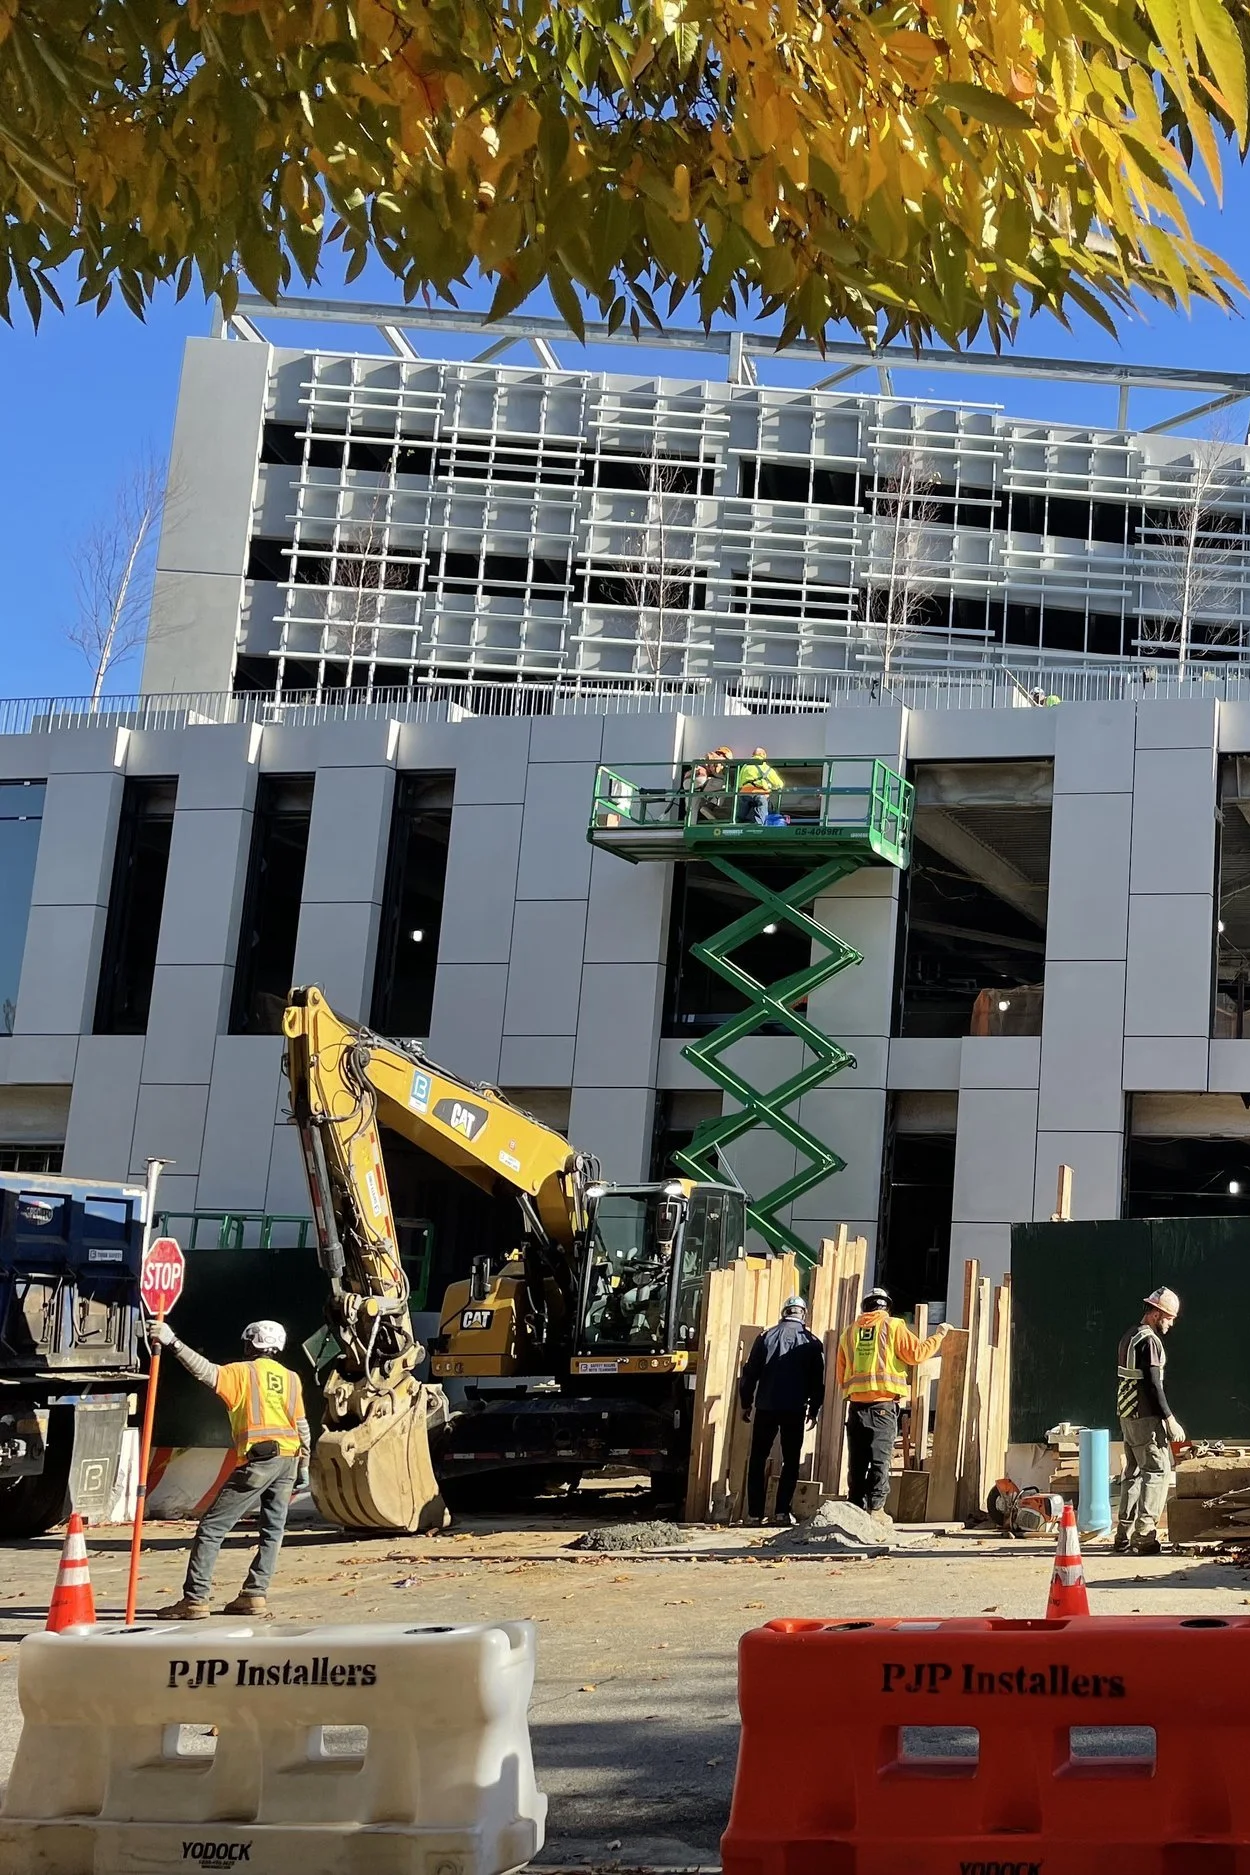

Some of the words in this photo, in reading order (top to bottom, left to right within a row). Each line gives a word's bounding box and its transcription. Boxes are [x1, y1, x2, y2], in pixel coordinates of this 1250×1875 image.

[794, 827, 844, 836] GS-4069RT
[450, 1103, 476, 1138] CAT
[144, 1262, 181, 1290] STOP
[463, 1311, 490, 1328] CAT
[166, 1659, 229, 1689] PJP
[235, 1656, 377, 1687] Installers
[881, 1662, 952, 1693] PJP
[961, 1663, 1127, 1697] Installers
[182, 1841, 252, 1861] YODOCK
[960, 1862, 1043, 1875] YODOCK
